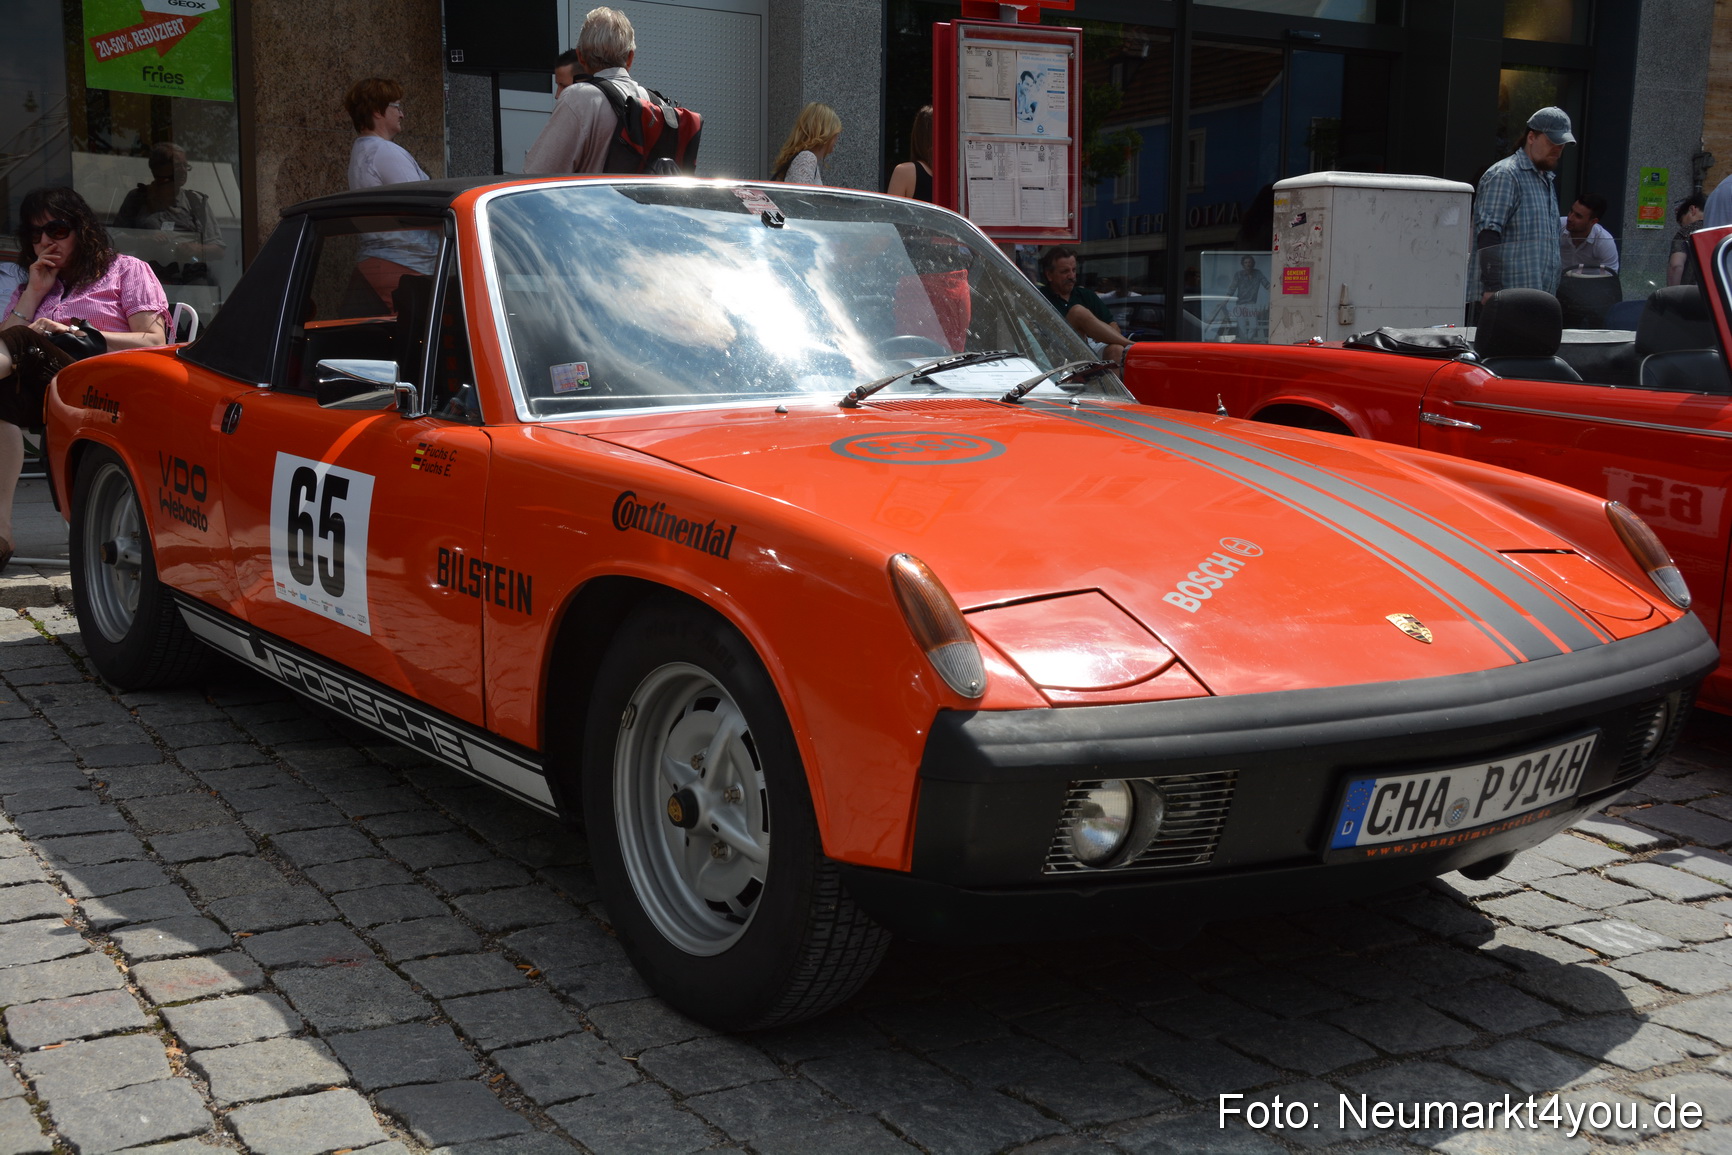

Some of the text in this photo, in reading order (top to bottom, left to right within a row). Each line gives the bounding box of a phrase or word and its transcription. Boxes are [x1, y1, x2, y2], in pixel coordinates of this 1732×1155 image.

[168, 0, 206, 10] GEOX
[95, 18, 187, 58] 20-50% REDUZIERT
[142, 65, 185, 85] Fries
[420, 458, 452, 477] Fuchs E.
[424, 444, 458, 463] Fuchs C.
[854, 438, 980, 456] ESSO
[158, 450, 208, 503] VDO
[158, 487, 208, 533] Webasto
[287, 466, 350, 598] 65
[612, 490, 738, 560] Continental
[437, 546, 533, 616] BILSTEIN
[1161, 551, 1247, 614] BOSCH
[276, 655, 470, 767] PORSCHE
[1367, 741, 1591, 836] CHA P 914H
[1341, 820, 1354, 836] D
[1366, 809, 1551, 857] www.youngtimer-treff.de
